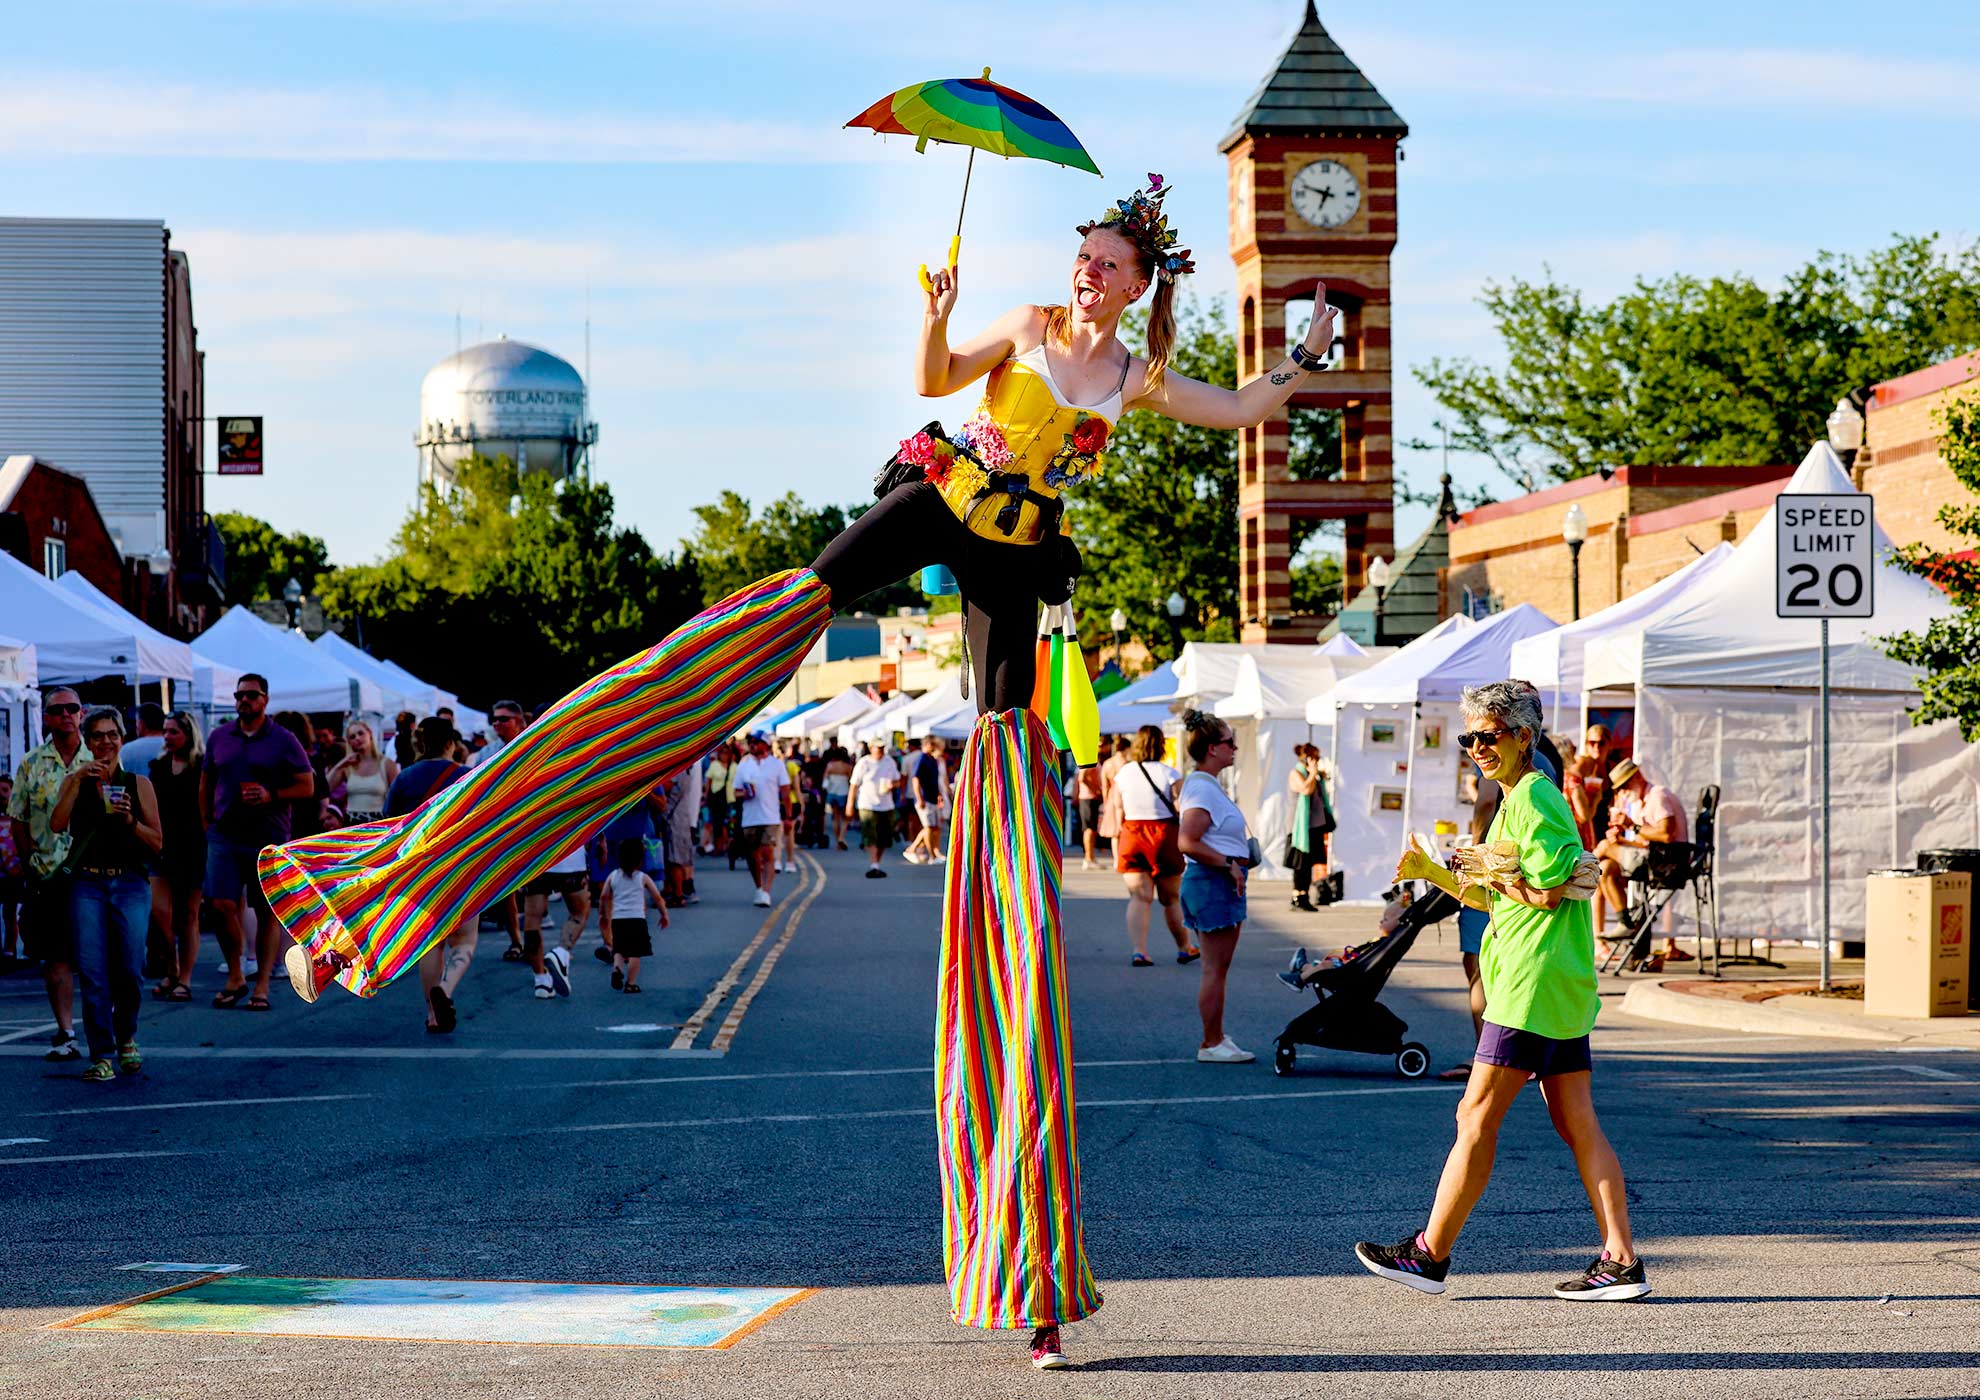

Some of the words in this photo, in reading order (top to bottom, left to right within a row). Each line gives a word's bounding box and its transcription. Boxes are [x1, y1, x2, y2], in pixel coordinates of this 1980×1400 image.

[473, 390, 555, 404] OVERLAND
[1785, 509, 1865, 527] SPEED
[1793, 534, 1855, 552] LIMIT
[1786, 563, 1863, 607] 20
